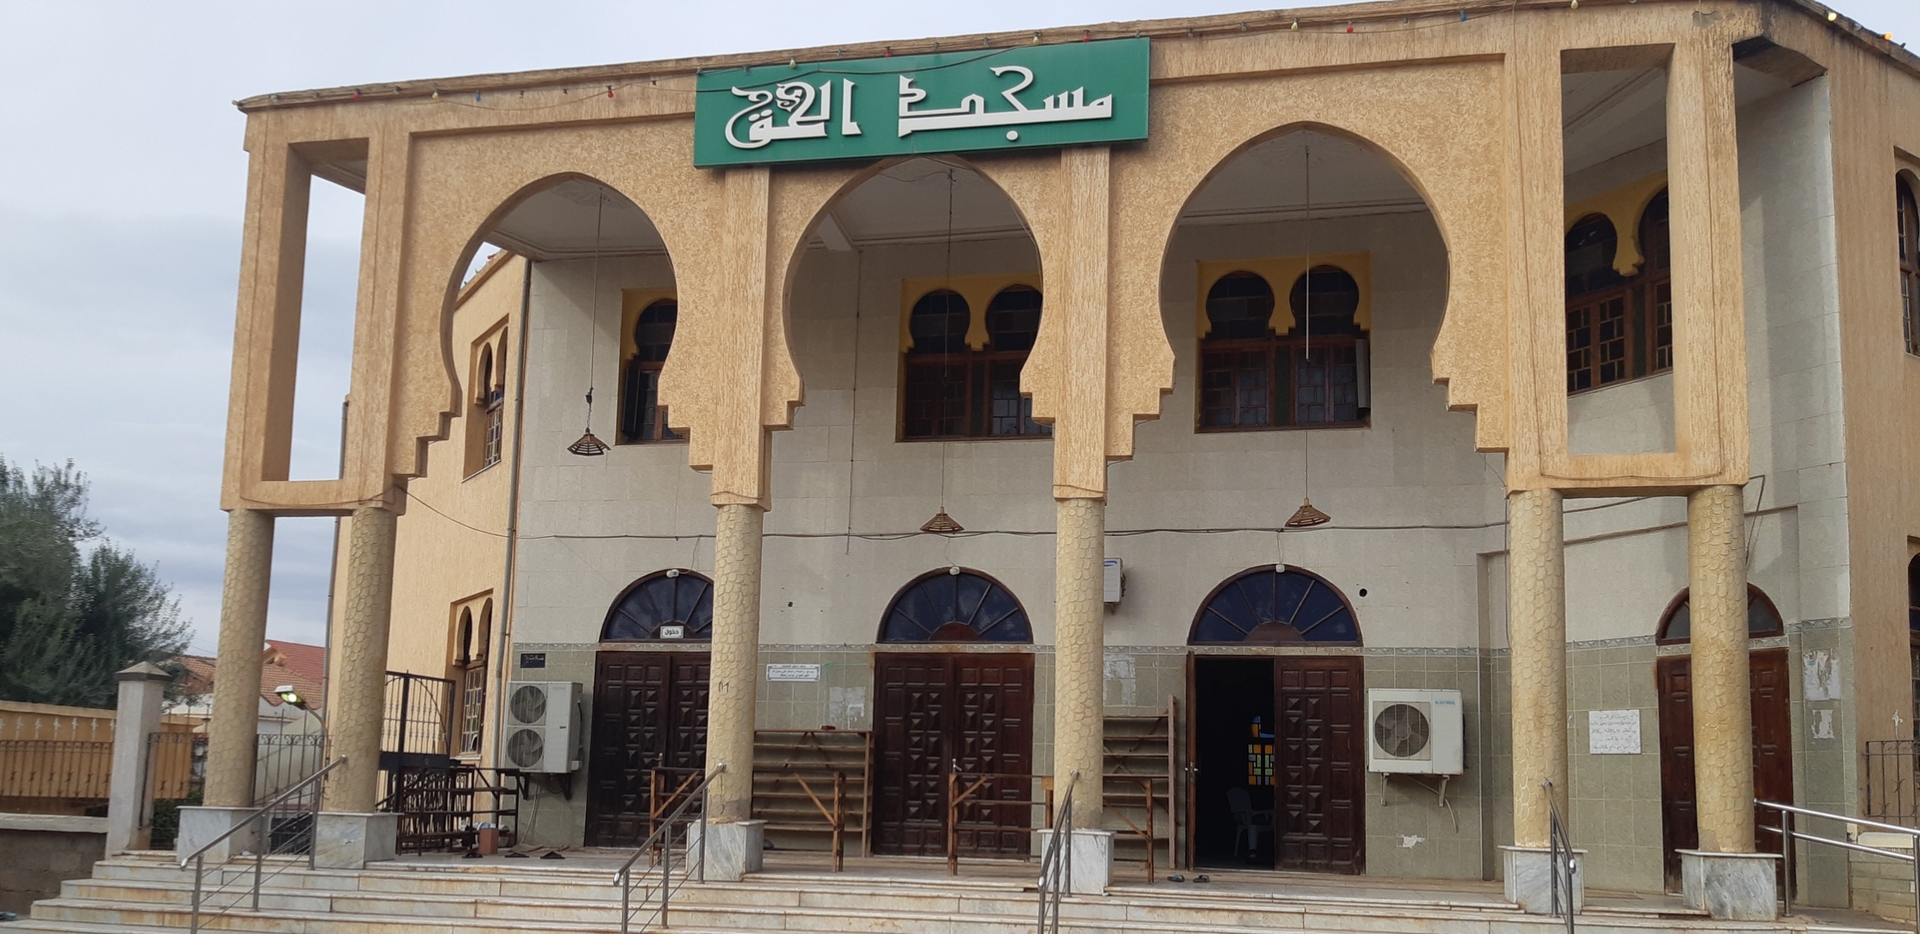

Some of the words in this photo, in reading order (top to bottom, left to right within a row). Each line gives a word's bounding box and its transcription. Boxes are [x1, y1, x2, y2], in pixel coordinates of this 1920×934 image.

[725, 77, 862, 149] الحق
[898, 65, 1113, 141] مسجد
[664, 629, 680, 637] دخول
